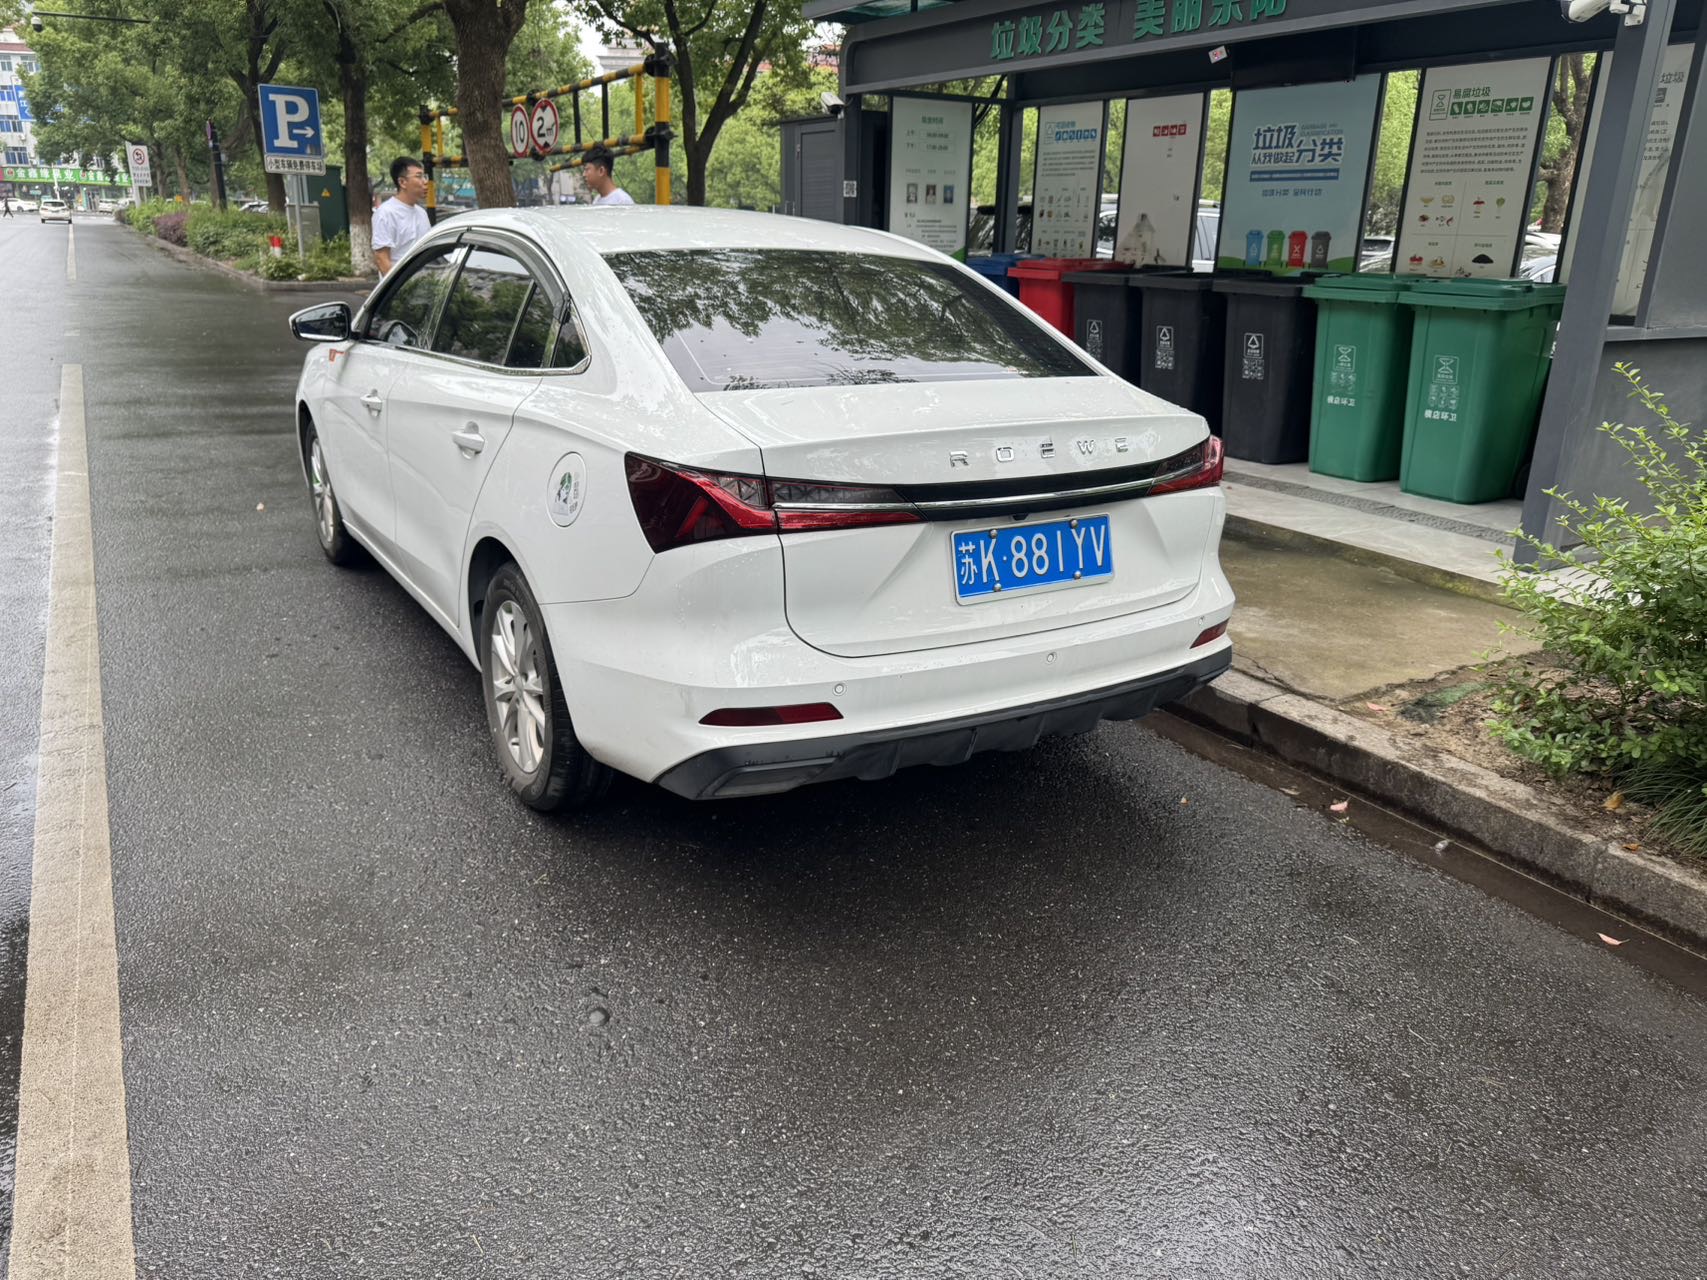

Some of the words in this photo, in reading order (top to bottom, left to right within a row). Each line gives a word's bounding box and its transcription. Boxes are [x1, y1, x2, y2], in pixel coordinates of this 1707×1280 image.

[991, 2, 1106, 60] 垃圾分类
[1453, 86, 1491, 99] 易腐垃圾
[268, 93, 310, 148] P
[514, 120, 526, 144] 10
[1251, 151, 1296, 165] 从我做起
[950, 436, 1129, 467] ROEWE
[957, 524, 1106, 586] 苏K·881YV
